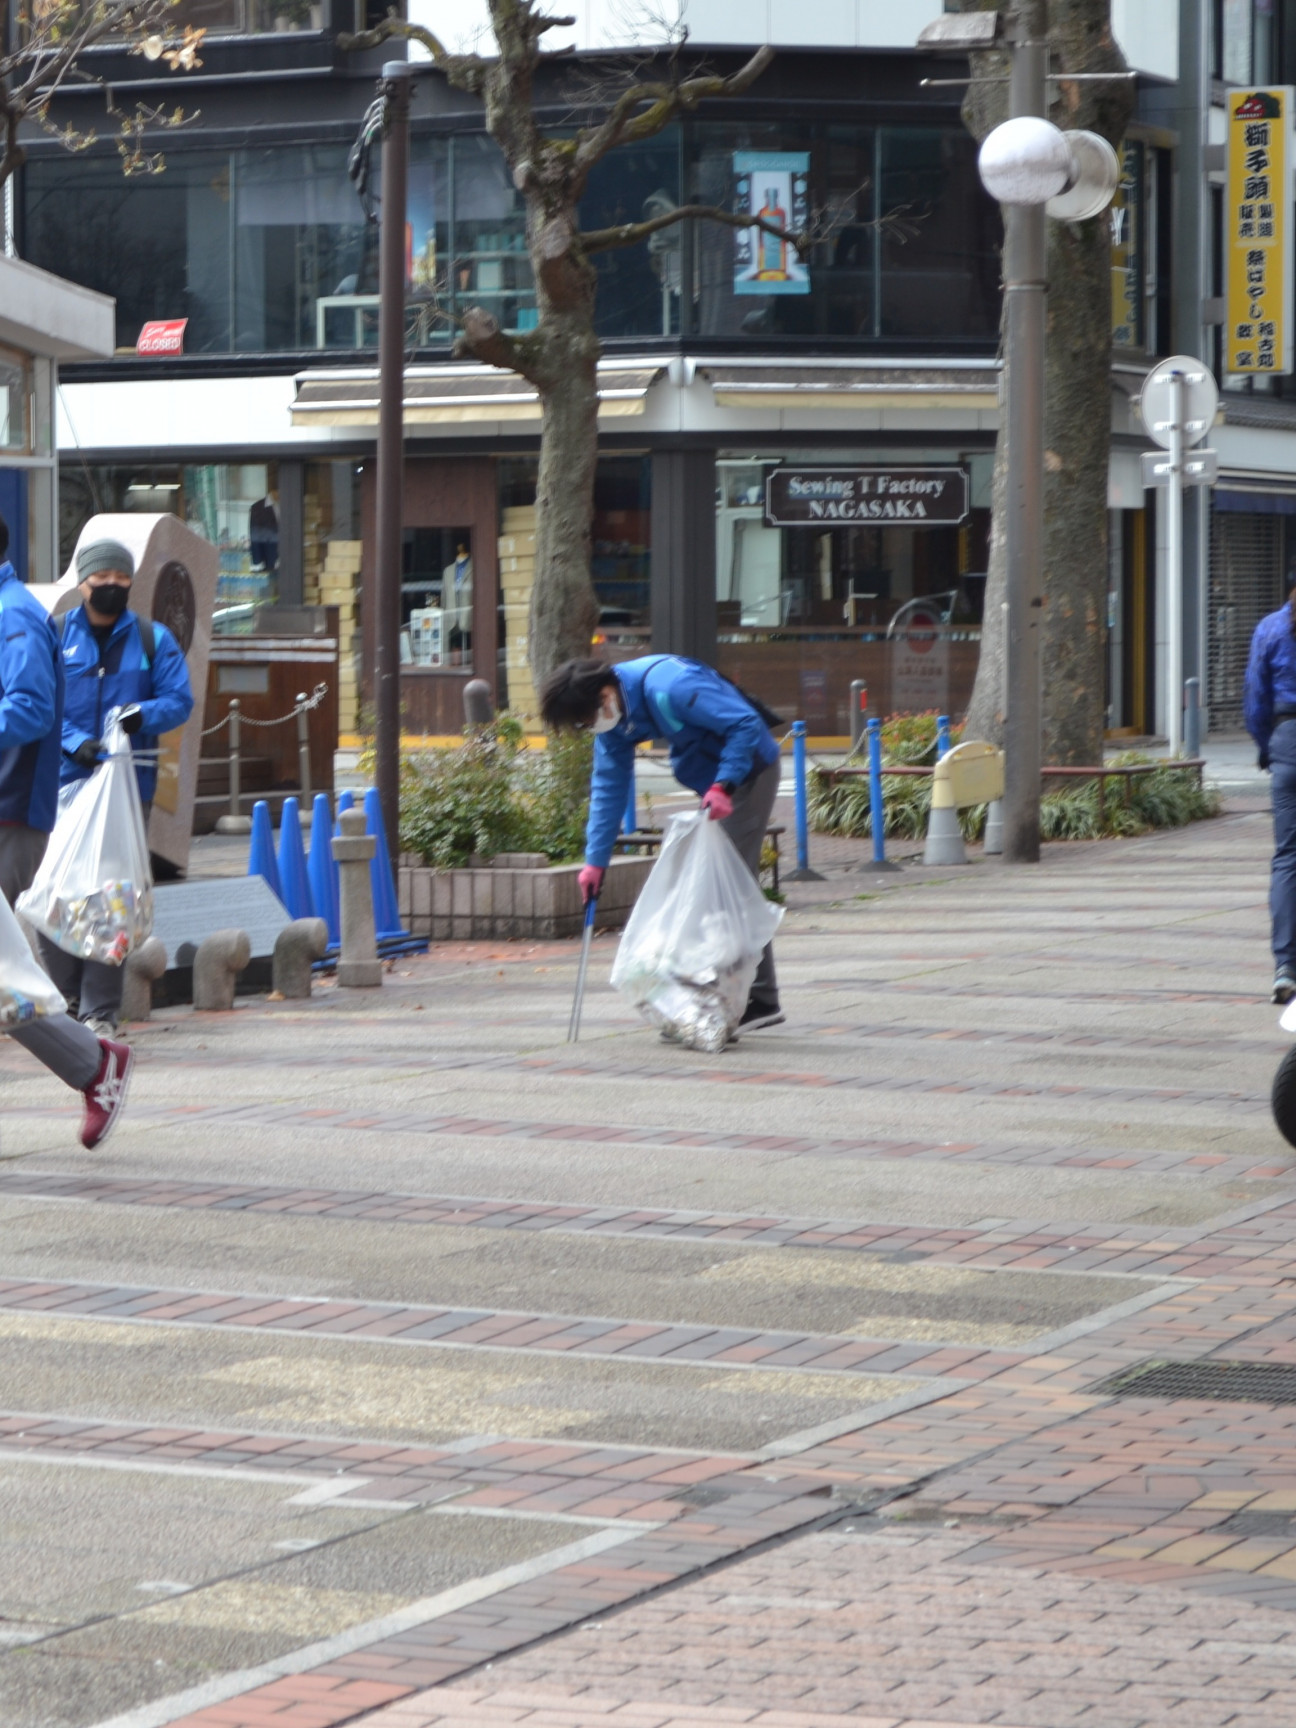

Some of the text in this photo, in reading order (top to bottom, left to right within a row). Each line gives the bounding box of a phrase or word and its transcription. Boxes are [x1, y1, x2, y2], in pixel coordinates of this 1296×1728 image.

[138, 337, 182, 352] CLOSED
[789, 476, 946, 498] Sewing T Factory
[808, 500, 928, 519] NAGASAKA
